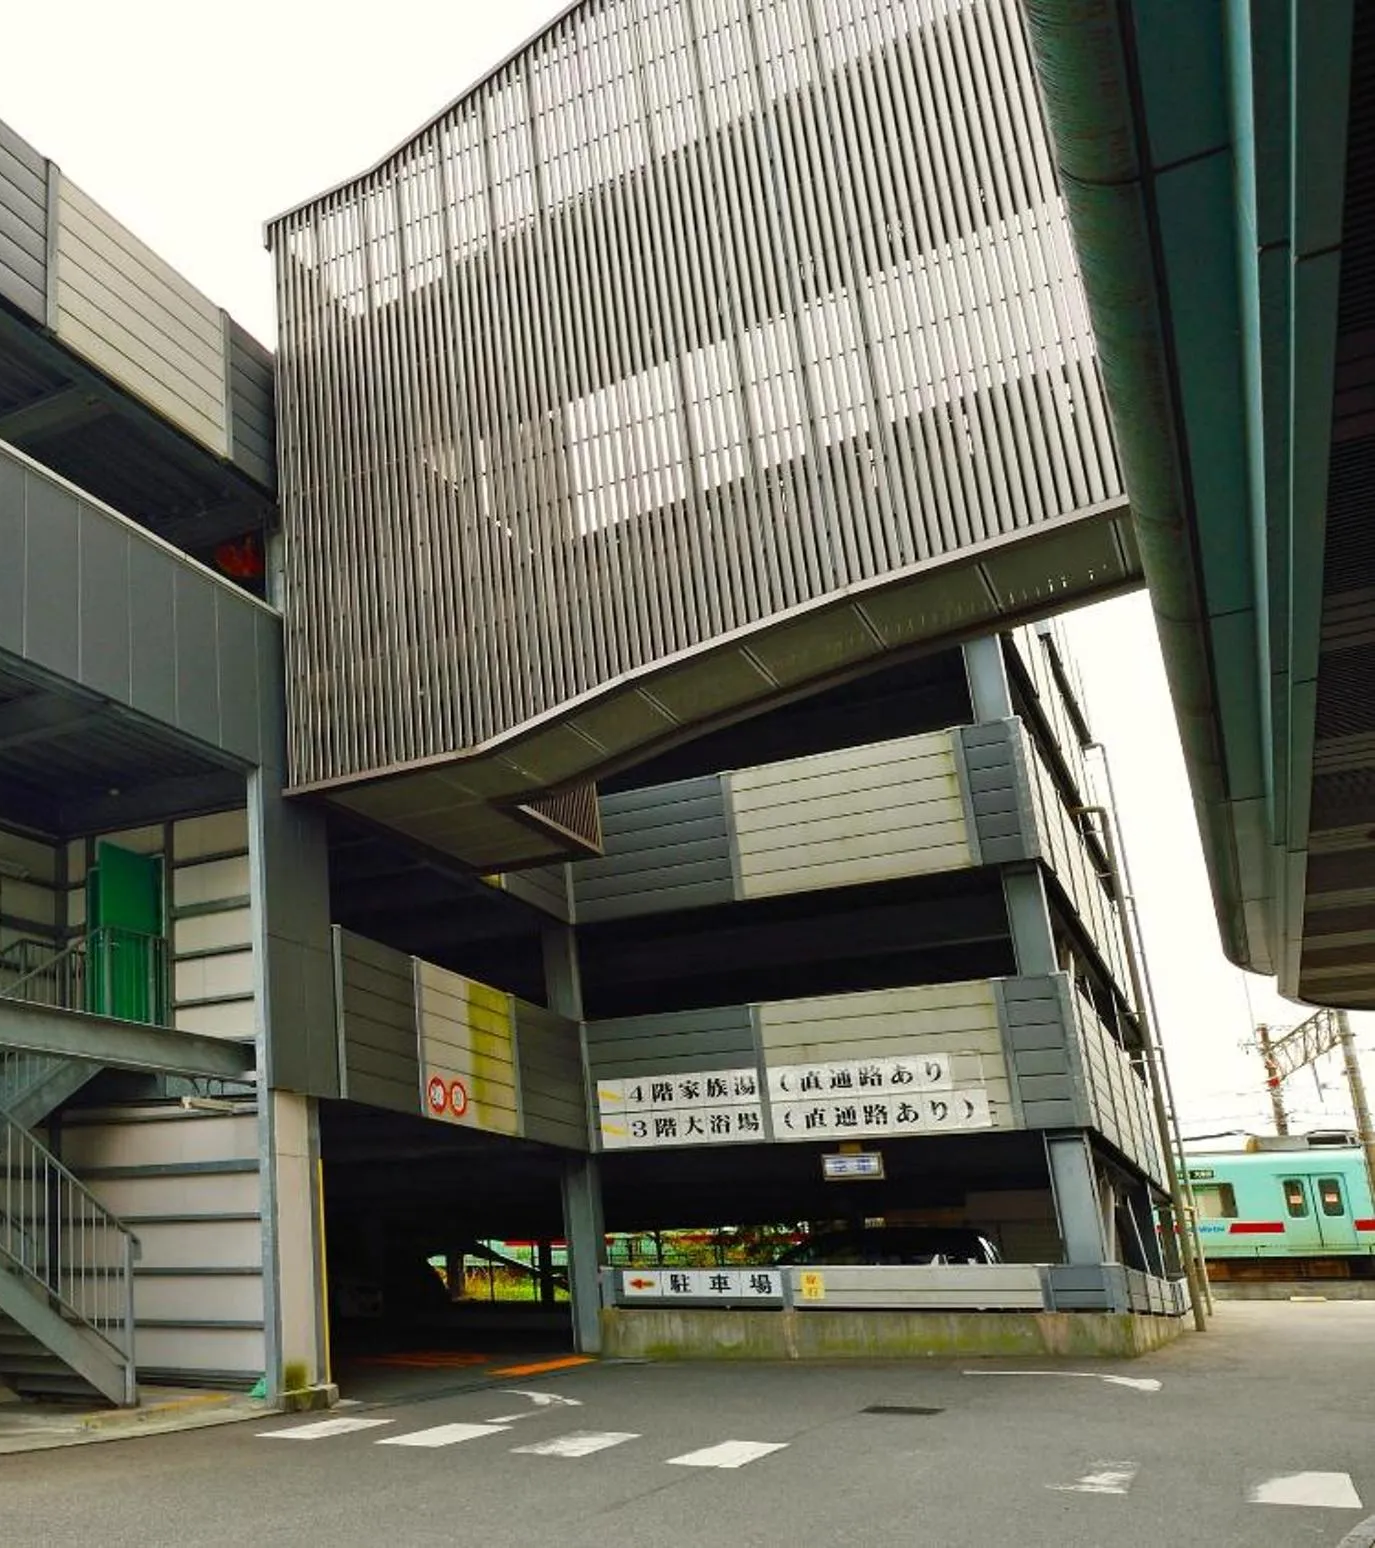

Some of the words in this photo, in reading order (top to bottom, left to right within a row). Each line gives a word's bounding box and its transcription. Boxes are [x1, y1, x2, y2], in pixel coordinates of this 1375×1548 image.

[631, 1112, 759, 1138] 3階大浴場
[669, 1273, 773, 1295] 駐車場
